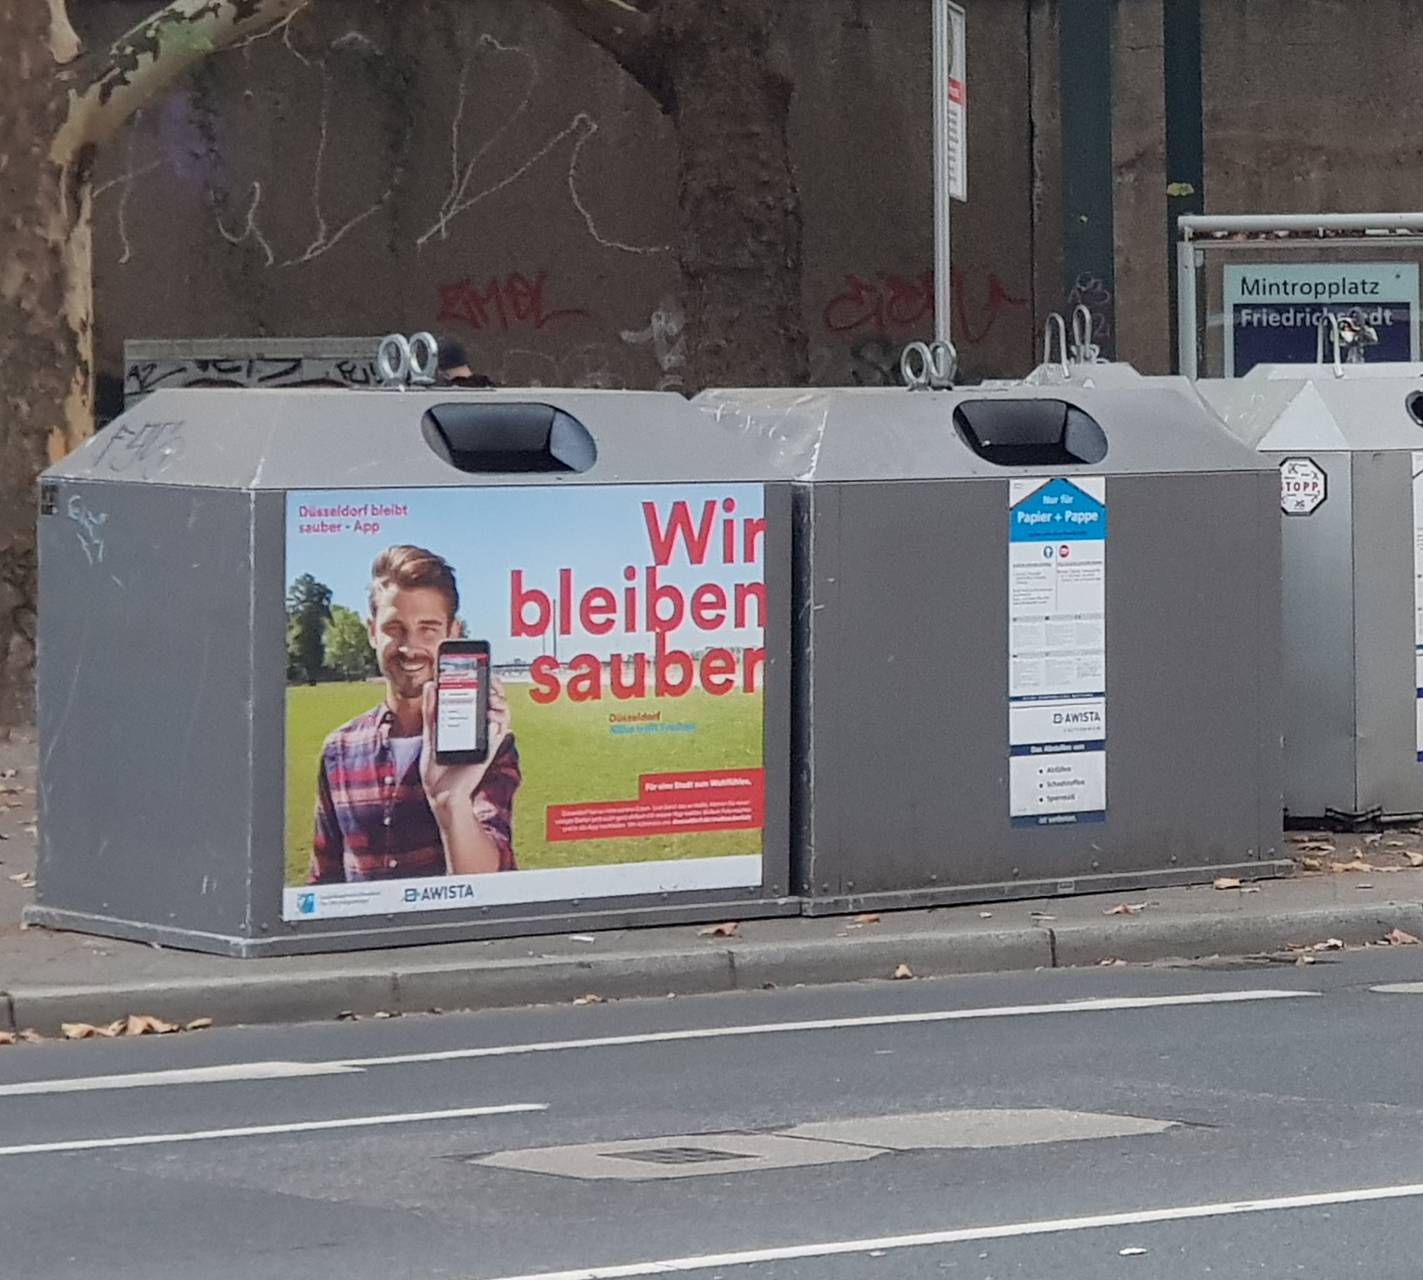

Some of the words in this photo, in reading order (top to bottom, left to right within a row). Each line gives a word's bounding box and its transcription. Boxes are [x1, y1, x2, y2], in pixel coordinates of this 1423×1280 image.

[1240, 275, 1380, 299] Mintropplatz
[1281, 481, 1319, 492] TOPP
[299, 503, 368, 518] Düsseldorf
[371, 503, 409, 517] bleibt
[1016, 510, 1053, 526] Papier
[1054, 512, 1063, 521] +
[1064, 509, 1099, 525] Pappe
[299, 520, 342, 533] sauber
[354, 519, 380, 534] App
[642, 497, 767, 566] Wir
[510, 565, 767, 638] bleiben
[528, 628, 767, 705] sauber
[1064, 712, 1101, 724] AWISTA
[421, 884, 475, 902] AWISTA
